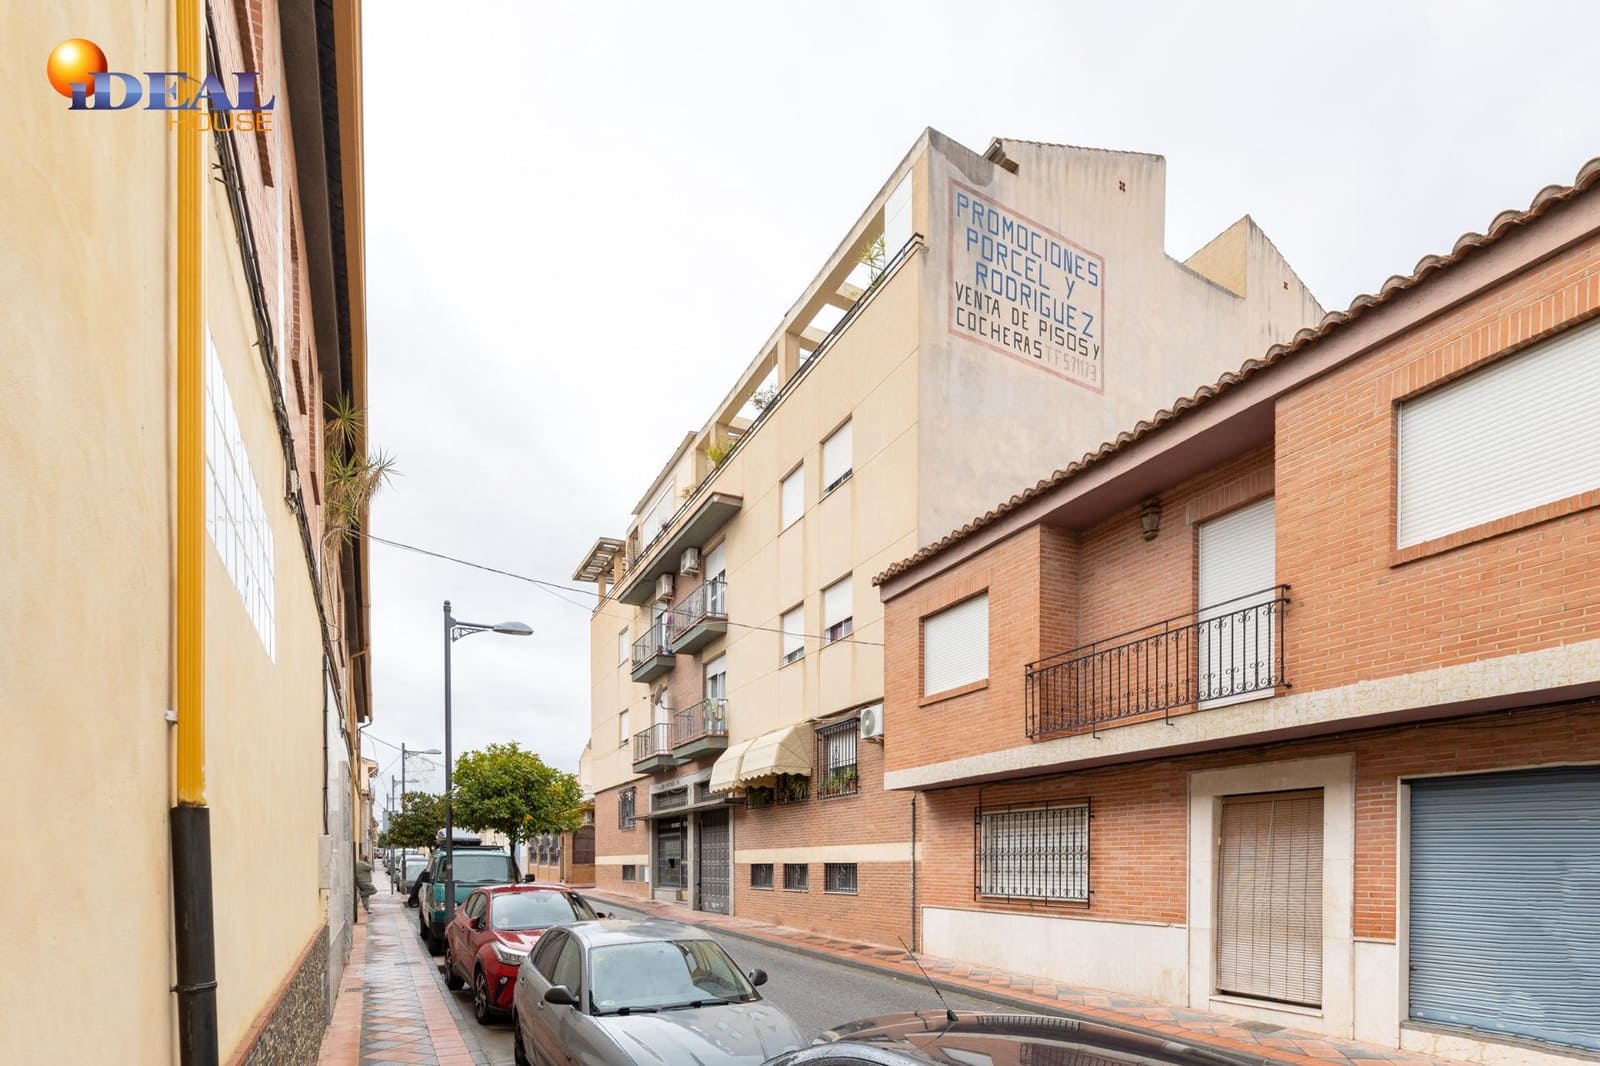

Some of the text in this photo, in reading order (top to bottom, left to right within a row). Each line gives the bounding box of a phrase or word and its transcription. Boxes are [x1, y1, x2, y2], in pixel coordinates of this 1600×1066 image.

[957, 192, 1098, 287] PROMOCIONES
[967, 227, 1050, 290] PORCEL
[955, 281, 1001, 319] VENTA
[1011, 307, 1029, 331] DE
[1039, 319, 1088, 357] PISOS
[956, 306, 1042, 359] COCHERAS
[975, 261, 1094, 338] RODRIGUEZ
